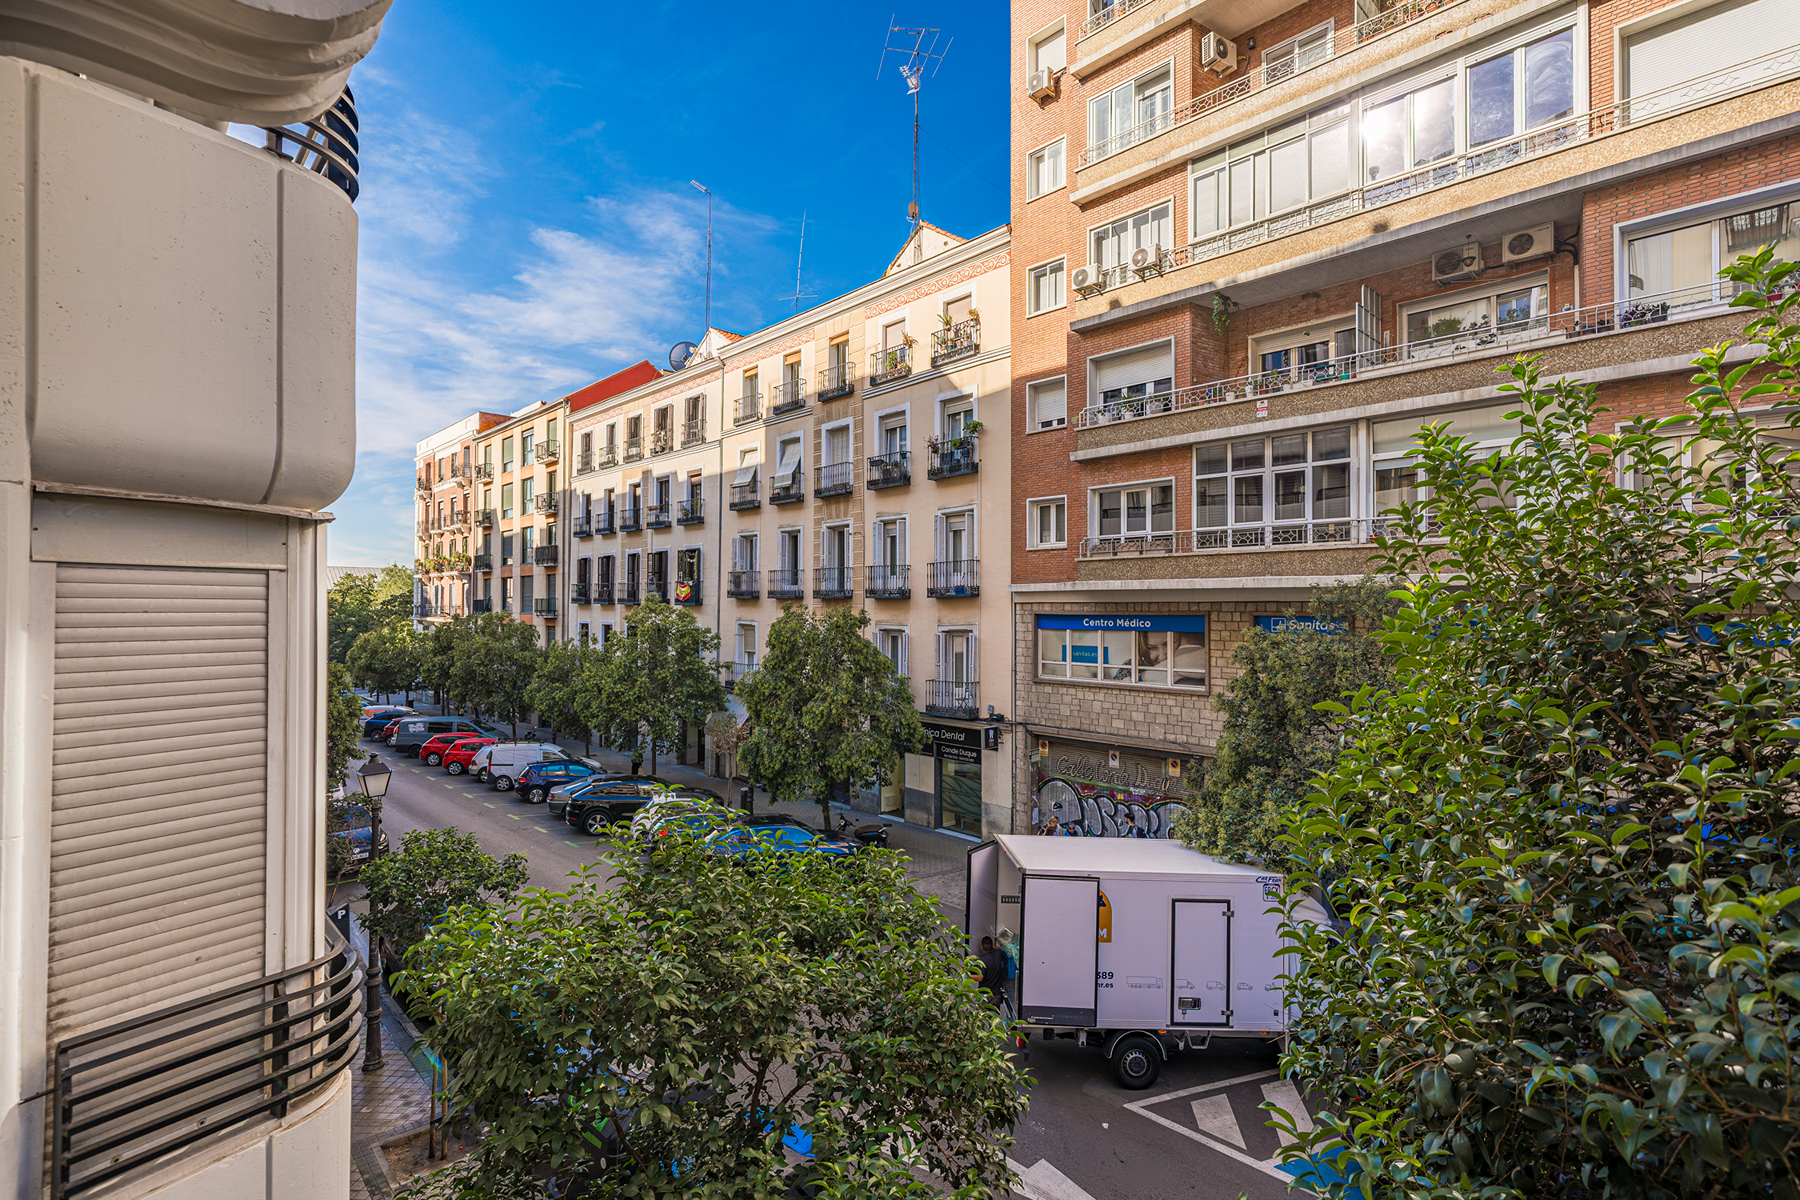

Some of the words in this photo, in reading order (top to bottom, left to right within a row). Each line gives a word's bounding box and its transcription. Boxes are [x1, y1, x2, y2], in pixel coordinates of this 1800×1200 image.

[1083, 618, 1114, 627] Centro
[1116, 618, 1152, 628] Médico
[1288, 619, 1335, 631] Sanitas
[1072, 650, 1098, 658] sanitas.es
[941, 729, 966, 741] Dental
[941, 745, 958, 755] Conde
[959, 748, 977, 759] Duque
[337, 909, 347, 920] P
